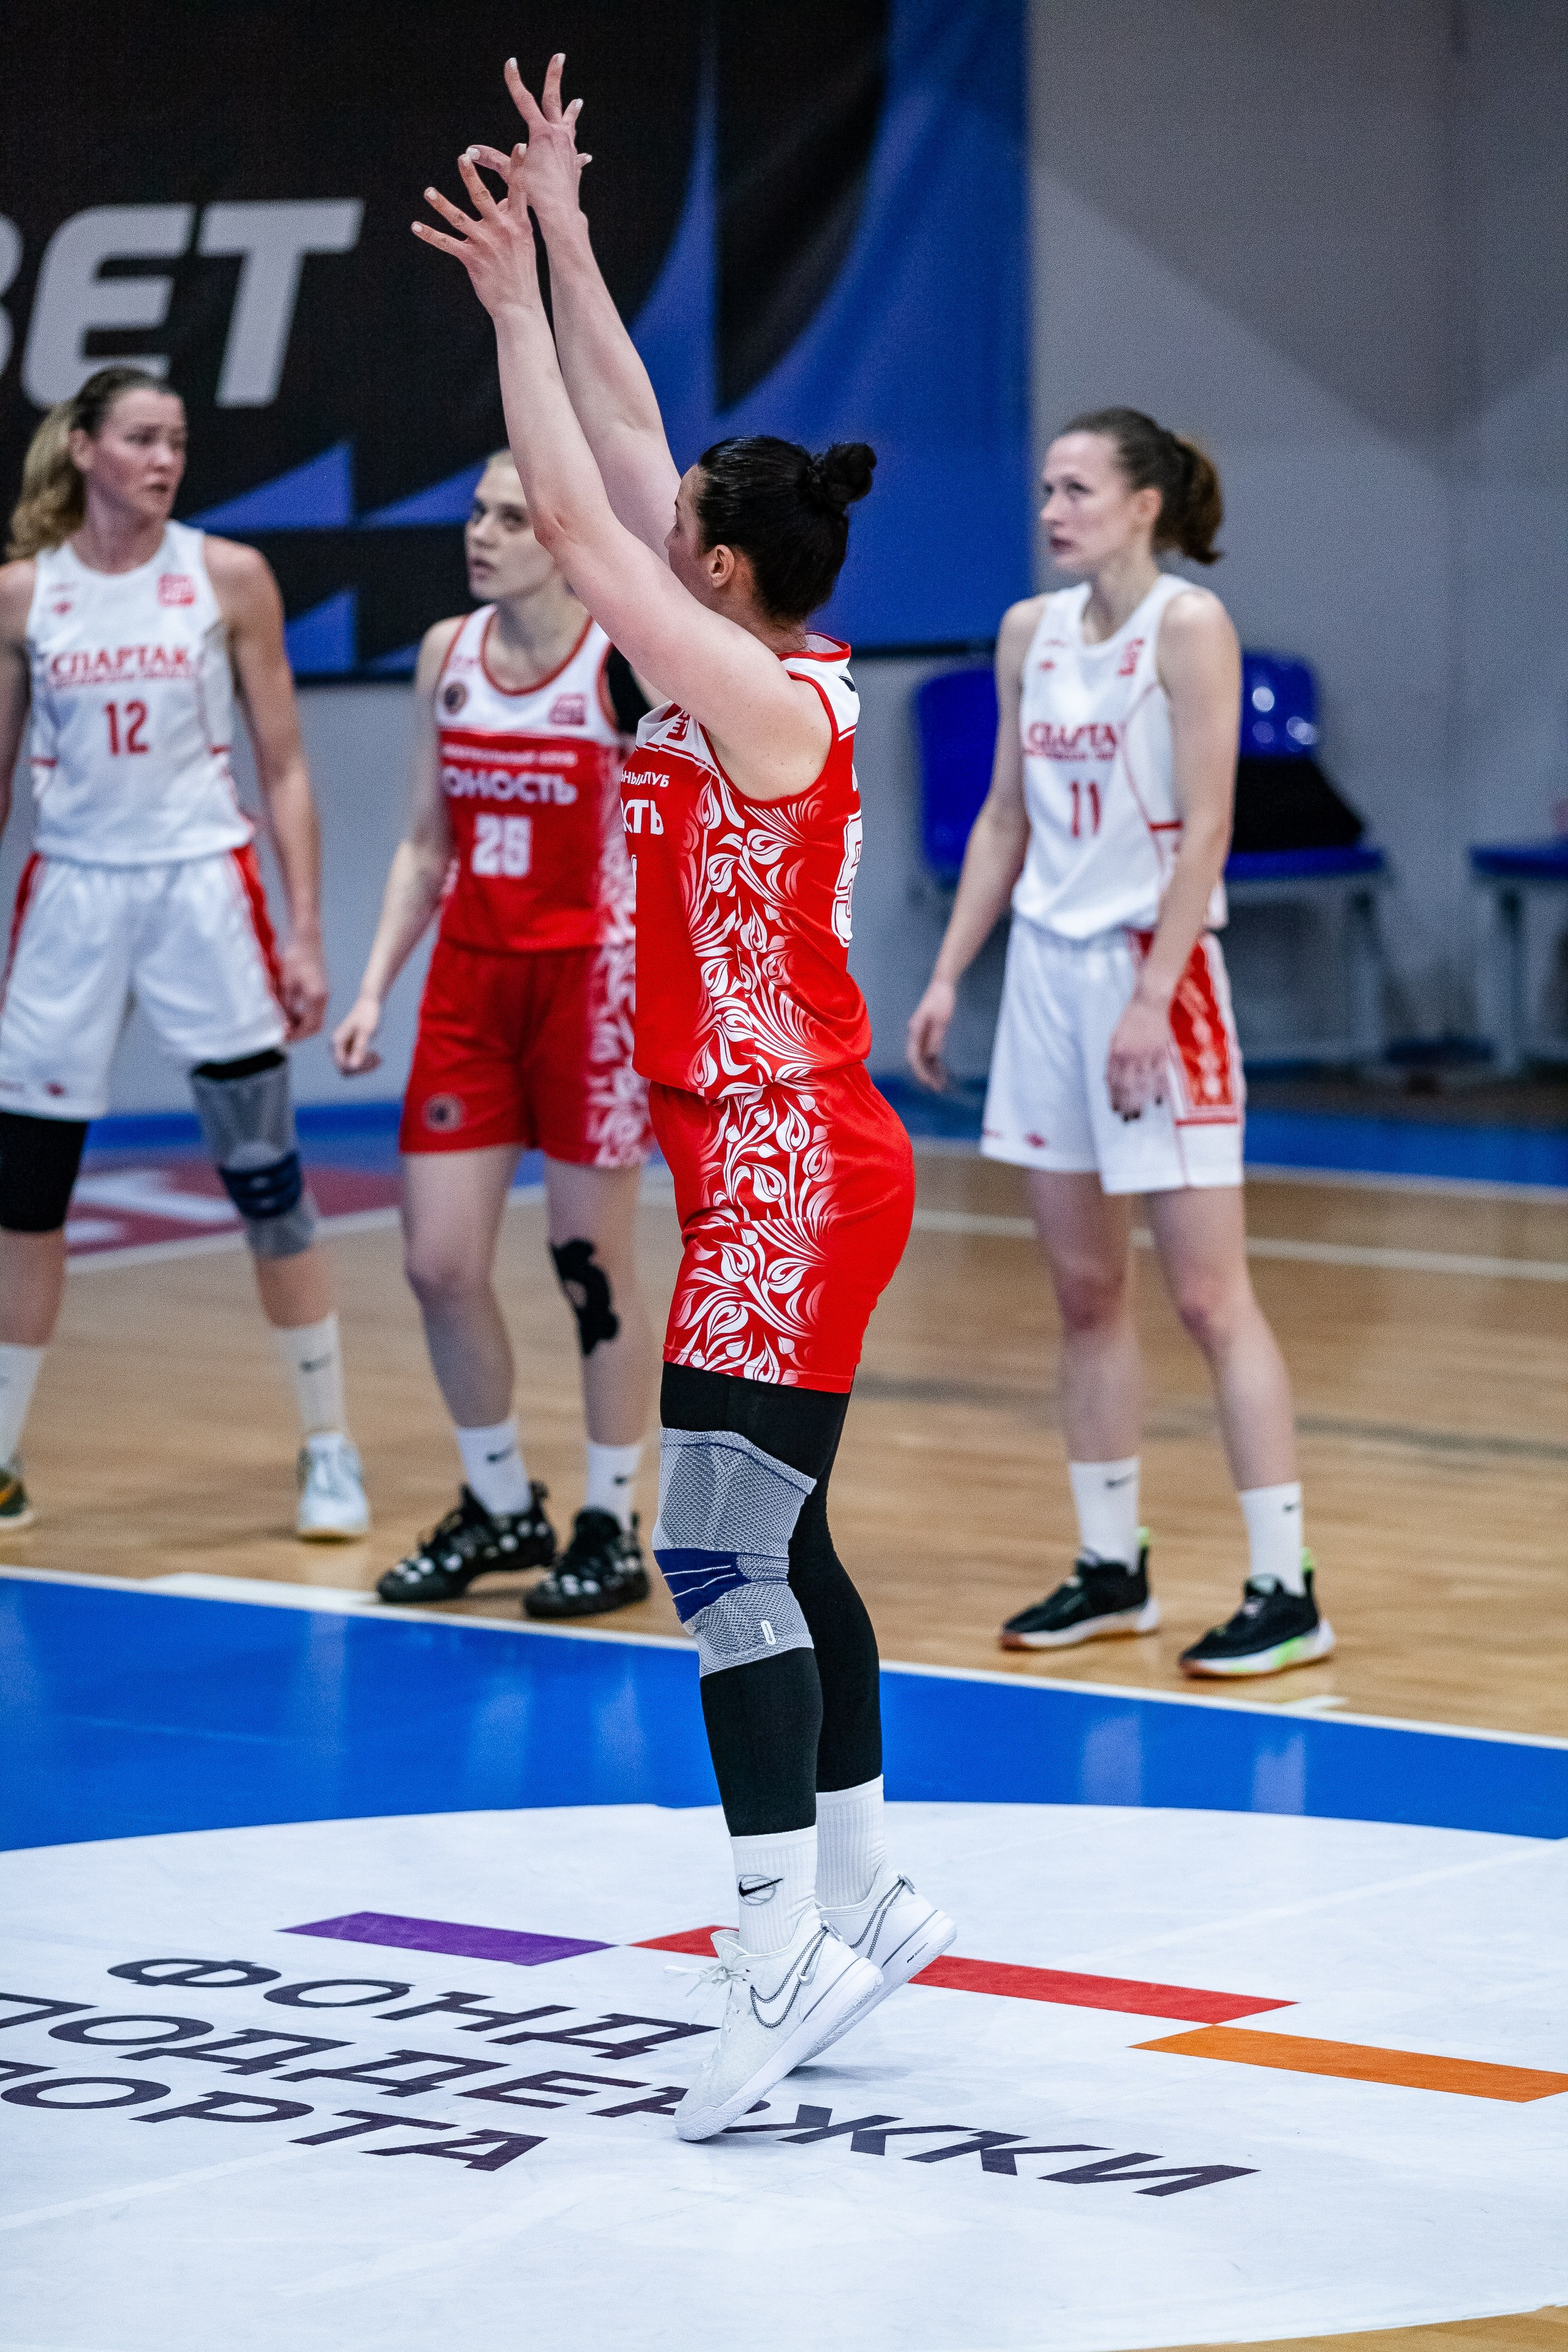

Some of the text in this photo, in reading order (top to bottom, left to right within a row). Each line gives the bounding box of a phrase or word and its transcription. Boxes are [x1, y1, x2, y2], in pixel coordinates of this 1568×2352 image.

[0, 197, 366, 409] ET
[104, 698, 149, 755] 12
[1071, 780, 1101, 839] 11
[107, 1958, 719, 2059] ФОНД
